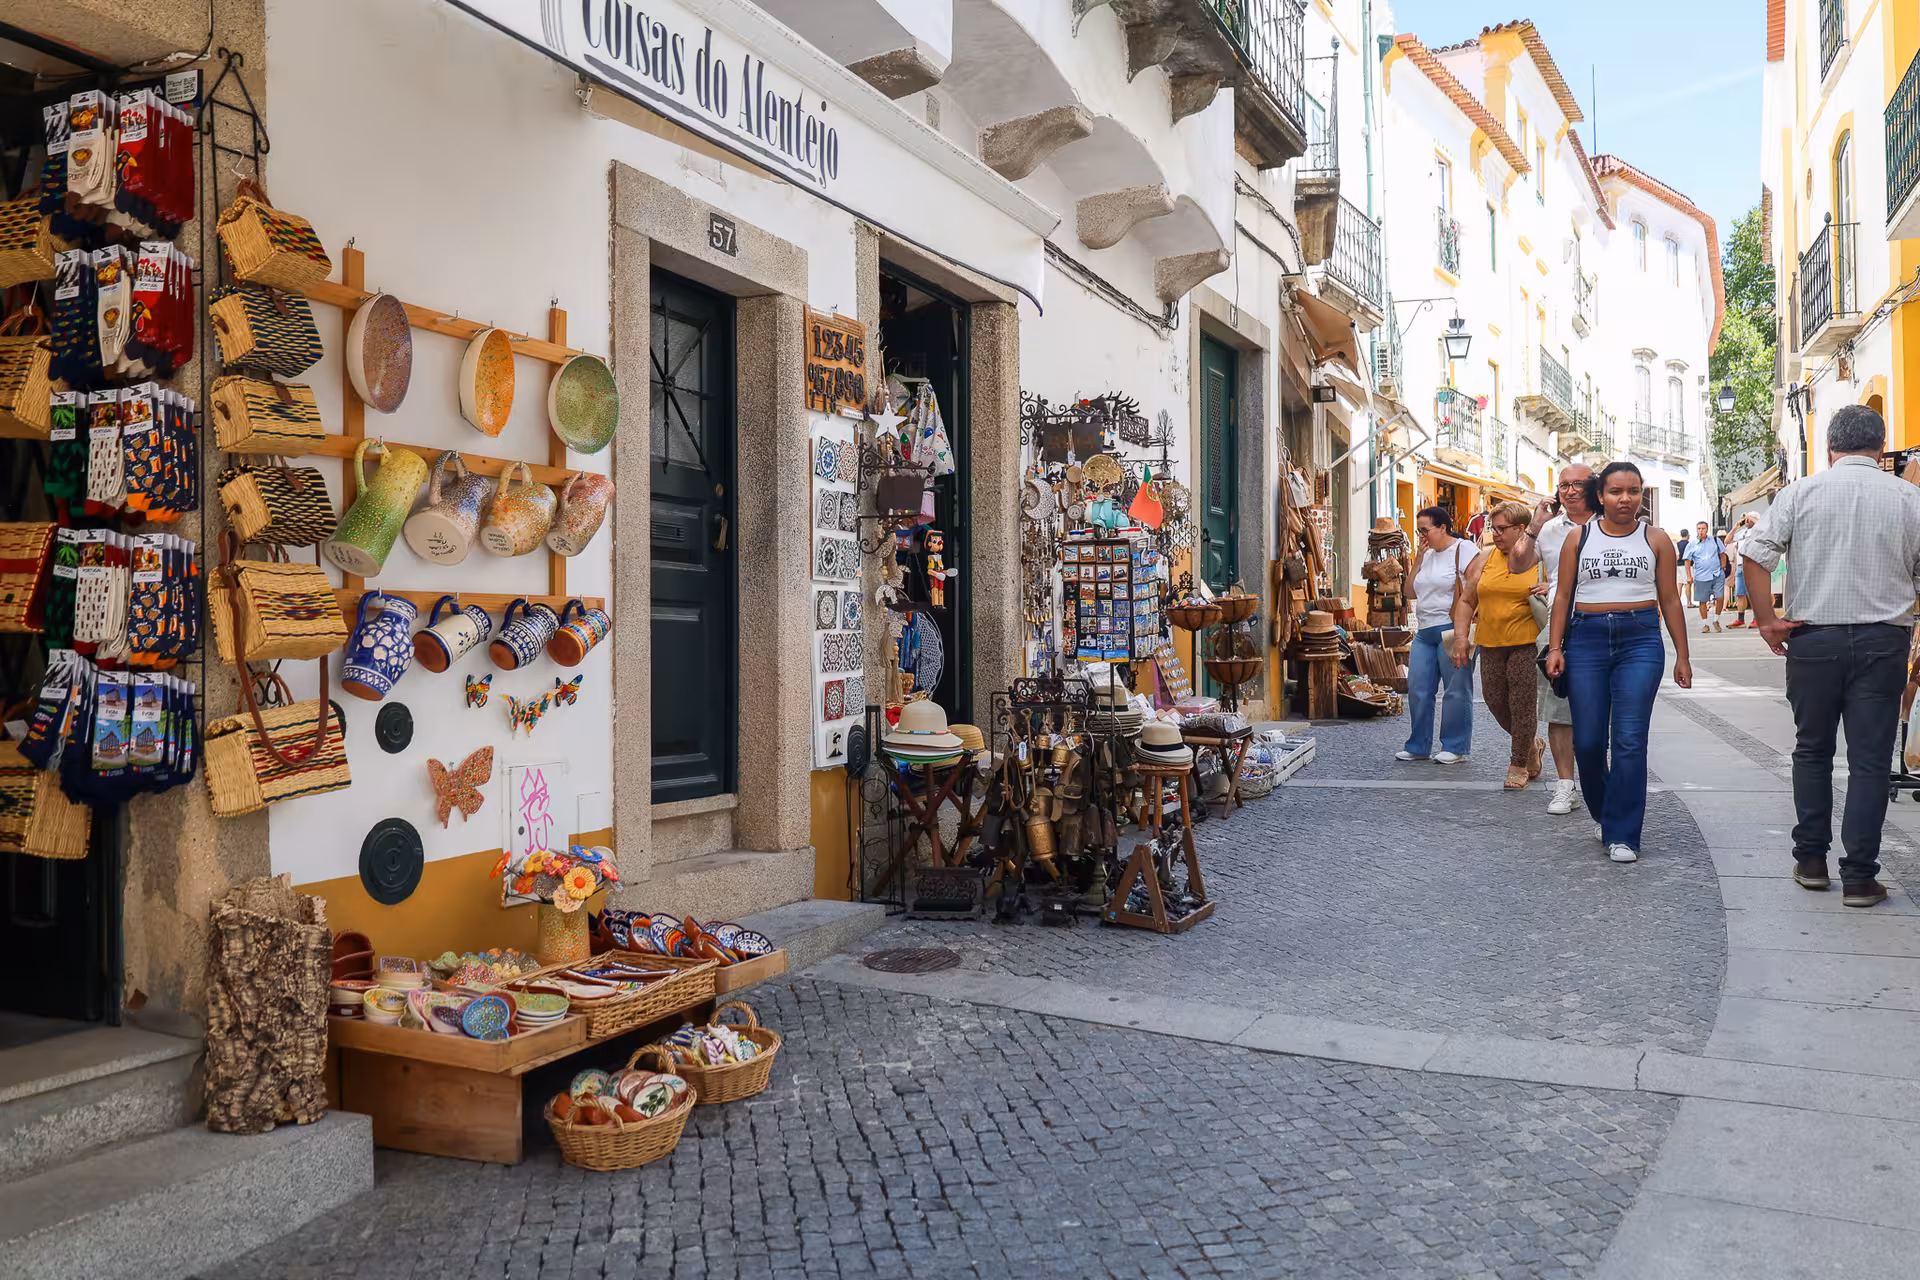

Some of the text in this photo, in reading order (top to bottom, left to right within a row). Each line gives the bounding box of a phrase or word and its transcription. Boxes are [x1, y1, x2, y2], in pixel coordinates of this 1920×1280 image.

[695, 26, 728, 119] do
[737, 54, 839, 189] Alentejo
[712, 220, 734, 251] 57
[1581, 557, 1648, 572] NEW ORLEANS
[1589, 568, 1637, 579] 19 91
